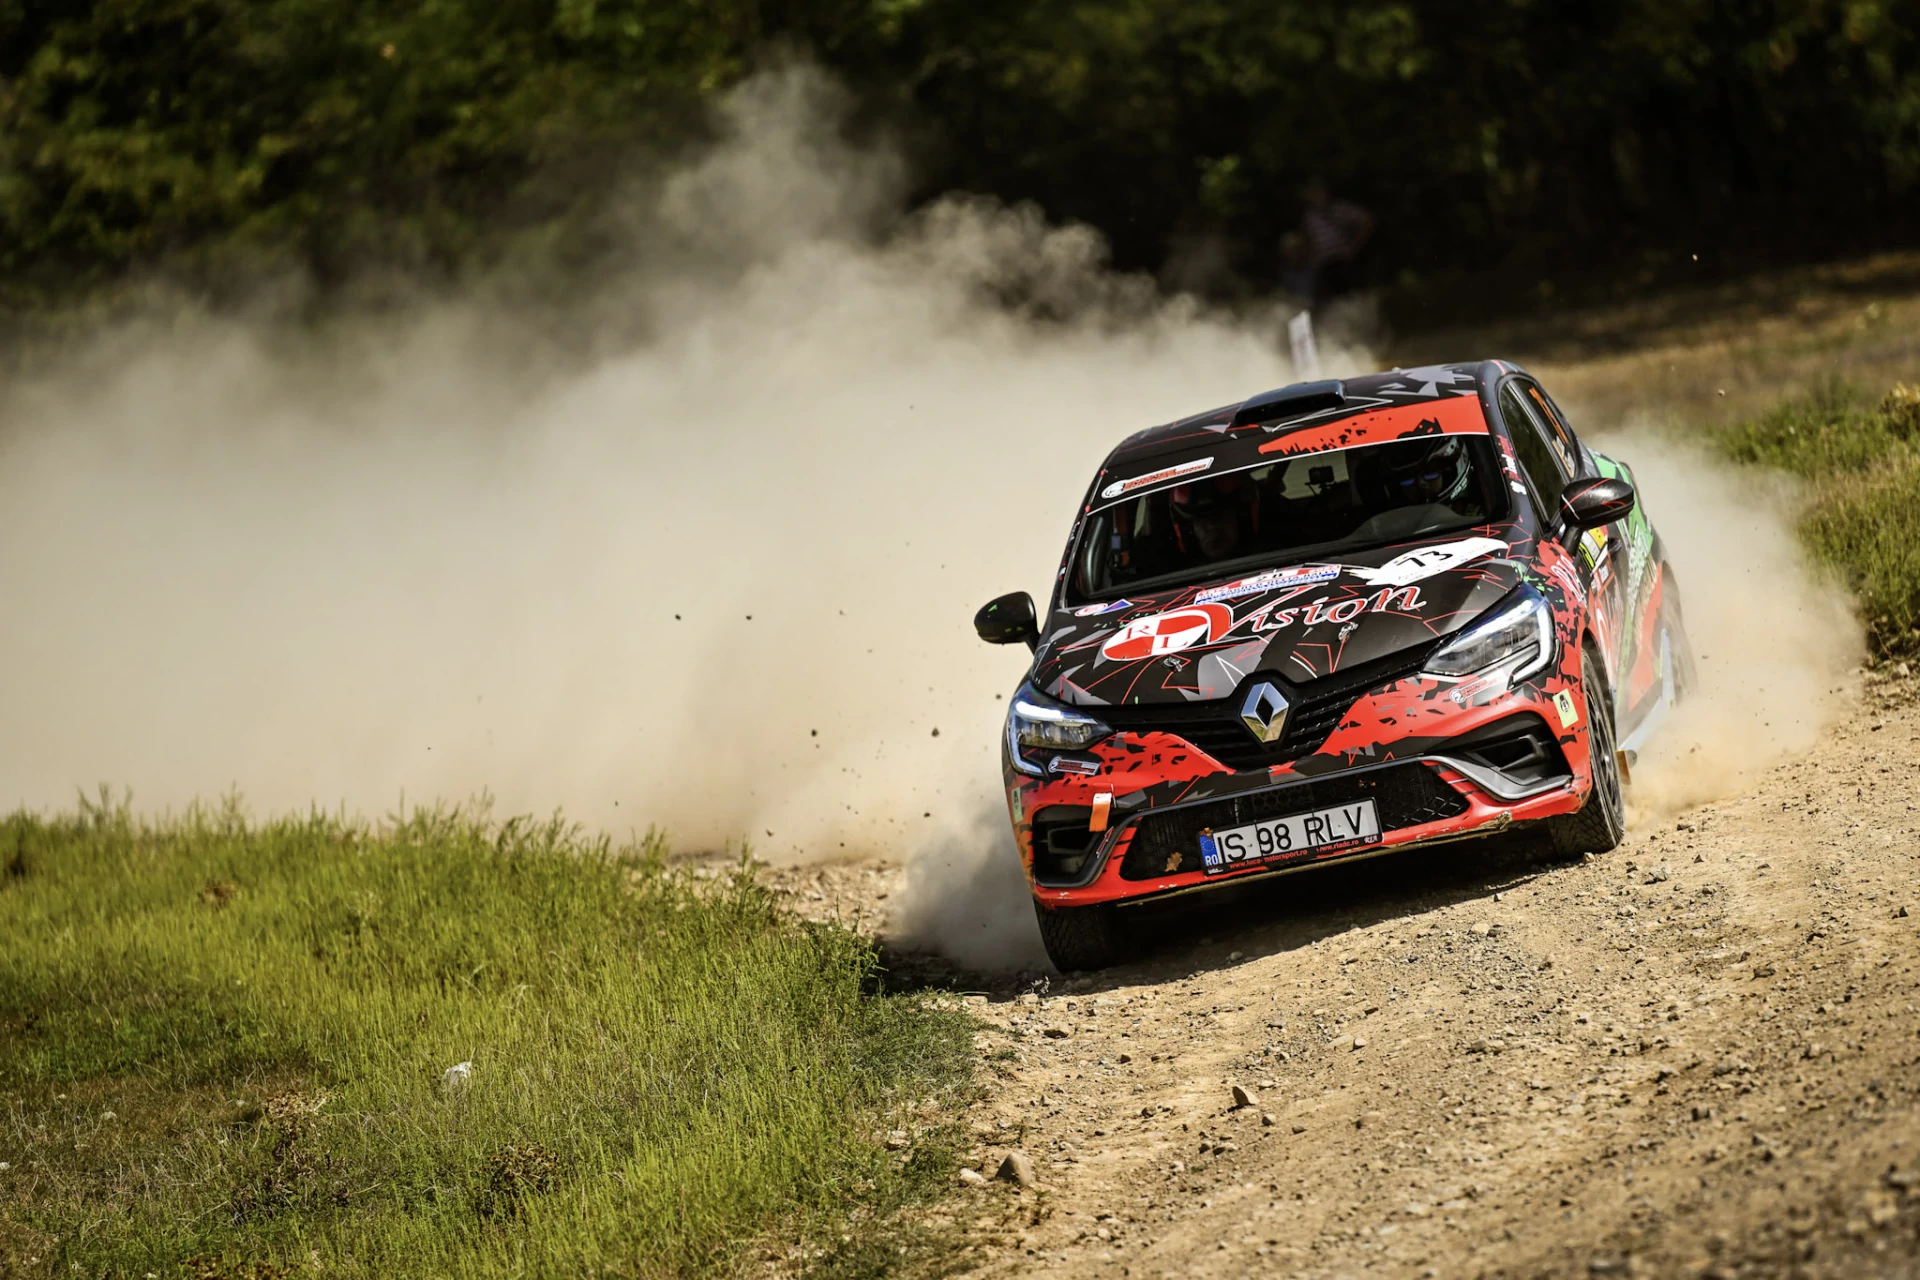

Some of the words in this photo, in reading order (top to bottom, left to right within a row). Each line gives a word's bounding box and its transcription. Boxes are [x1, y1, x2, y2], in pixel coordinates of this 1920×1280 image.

[1397, 550, 1453, 568] 73
[1217, 833, 1247, 864] IS
[1256, 823, 1292, 855] 98
[1303, 806, 1362, 846] RLV
[1205, 854, 1219, 866] RO
